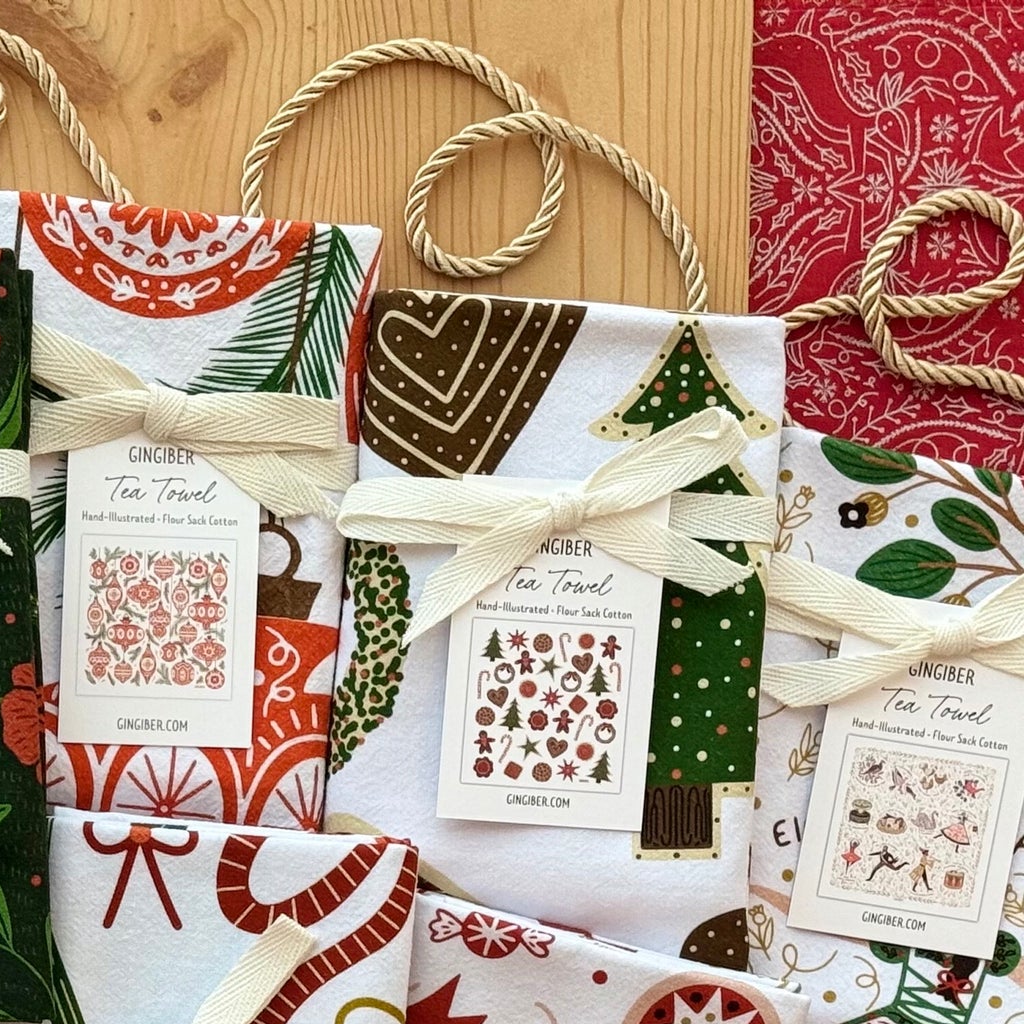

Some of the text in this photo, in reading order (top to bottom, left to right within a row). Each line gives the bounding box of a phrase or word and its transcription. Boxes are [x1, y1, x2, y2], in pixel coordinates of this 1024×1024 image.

[129, 446, 195, 465] GINGIBER
[105, 475, 217, 504] Tea Towel
[82, 511, 238, 526] Hand-Illustrated Flour Sack Cotton
[536, 538, 593, 558] NGIBER
[506, 565, 613, 596] Tea Towel
[476, 600, 632, 620] Hand-Illustrated Flour Sack Cotton
[881, 687, 993, 725] Tea Towel
[117, 718, 188, 732] GINGIBER.COM
[852, 718, 1008, 751] Hand-Illustrated Flour Sack Cotton
[506, 794, 570, 808] GINGIBER.COM
[862, 911, 926, 932] GINGIBER.COM
